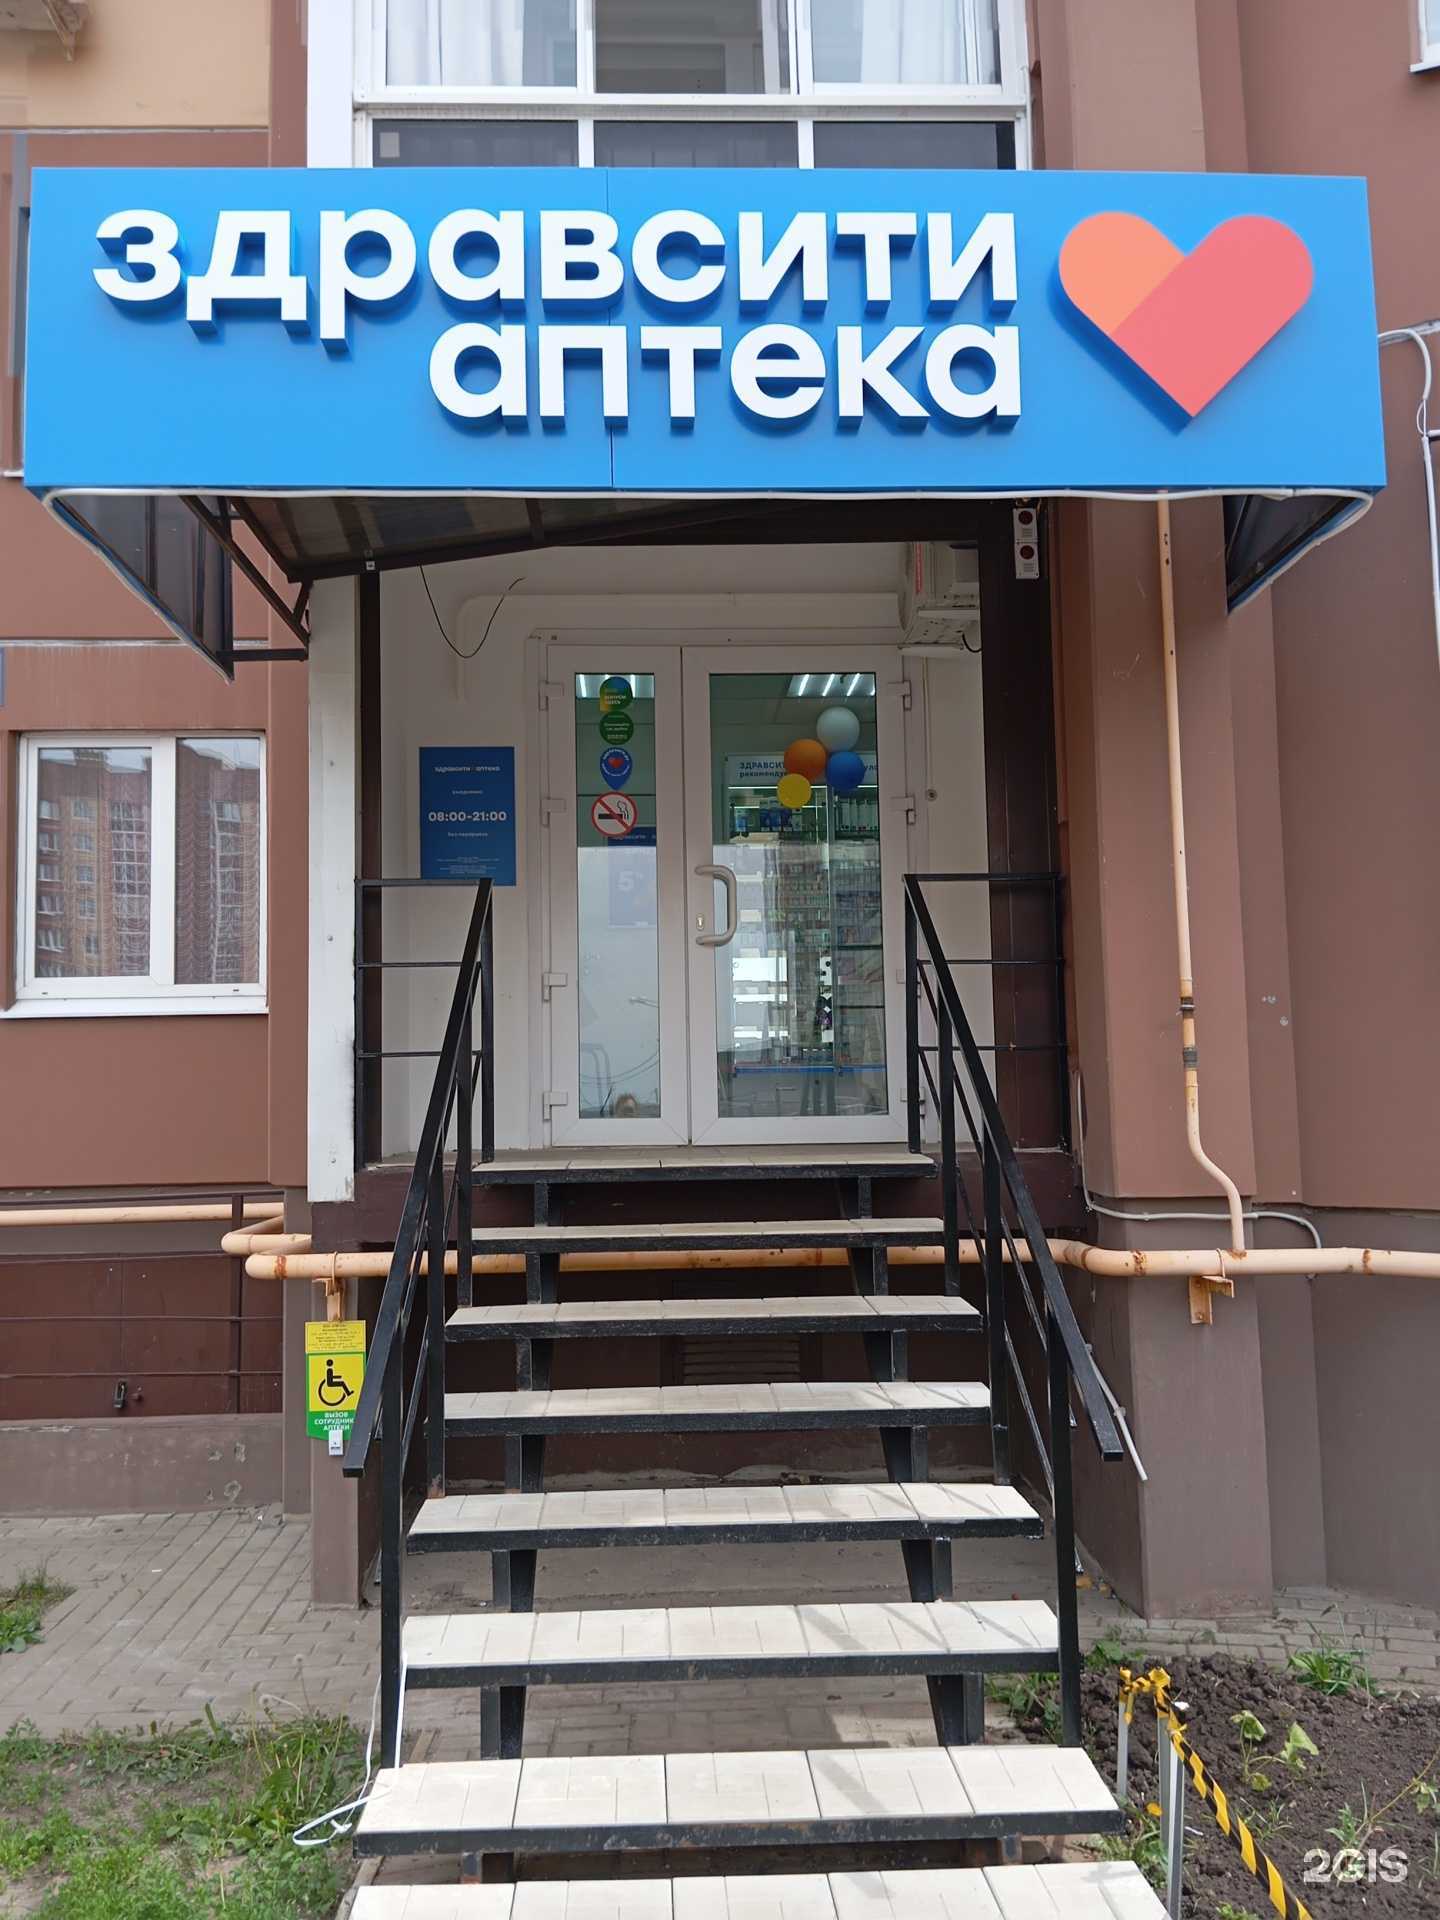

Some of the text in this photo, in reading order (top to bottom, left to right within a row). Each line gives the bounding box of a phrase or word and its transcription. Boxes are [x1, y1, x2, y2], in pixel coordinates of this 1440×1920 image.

[93, 208, 1018, 340] здравсити
[429, 322, 1022, 419] аптека
[428, 811, 508, 822] 08:00-21:00
